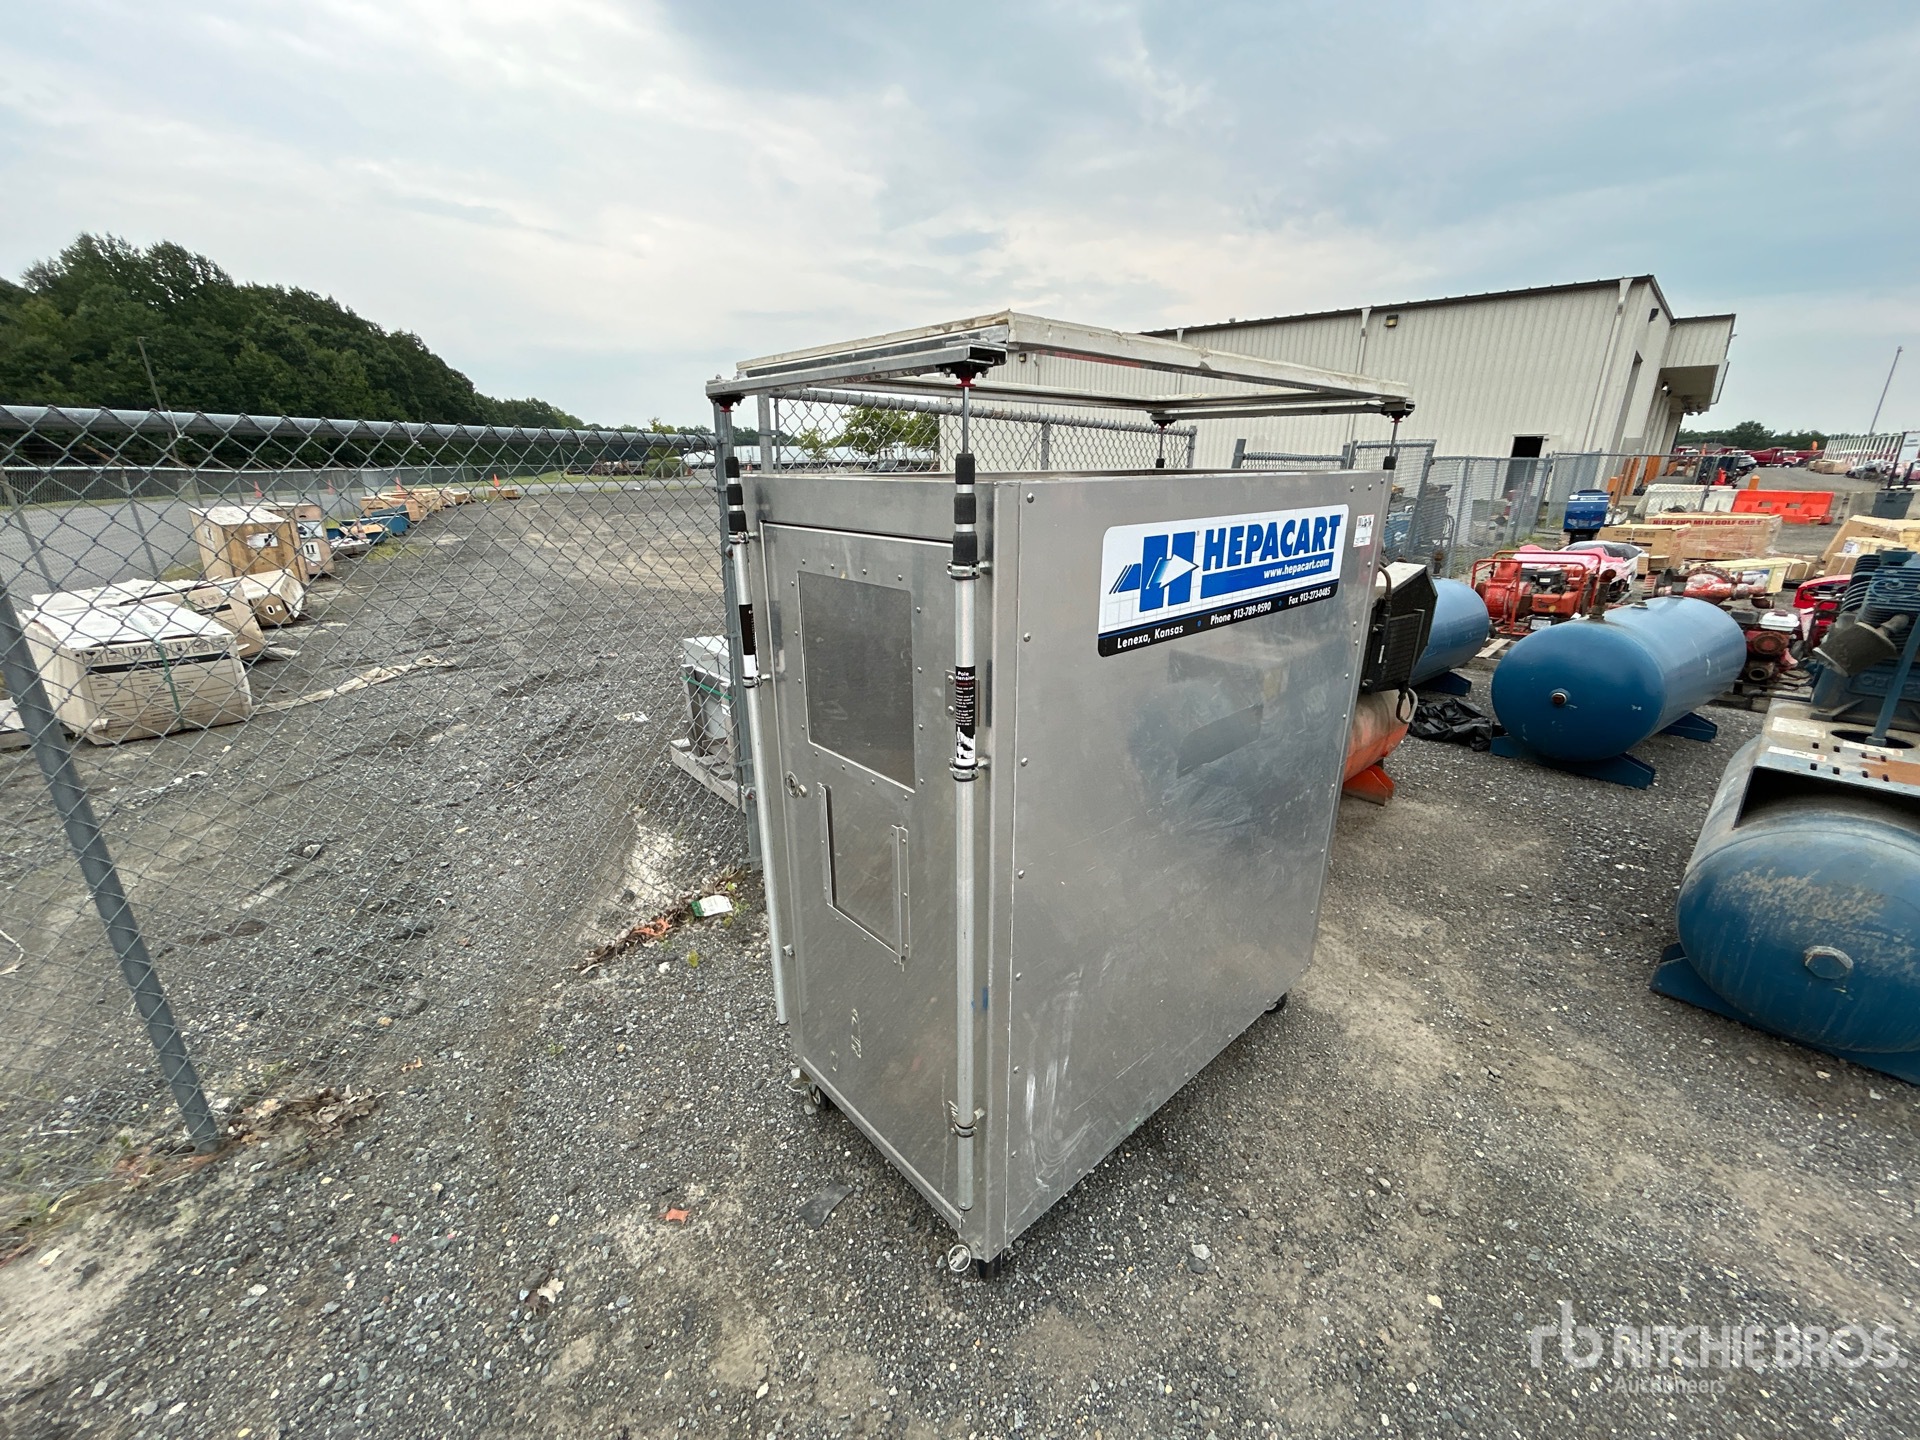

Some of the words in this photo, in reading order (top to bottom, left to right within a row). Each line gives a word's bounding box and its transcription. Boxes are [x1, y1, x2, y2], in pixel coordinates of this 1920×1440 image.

[1202, 514, 1342, 572] HEPACART
[1263, 558, 1330, 579] www.hepacart.com
[1288, 596, 1298, 605] Fax
[1210, 613, 1231, 625] Phone
[1233, 601, 1272, 619] 913-789-9590
[1117, 633, 1151, 649] Lenexa,
[1154, 625, 1184, 640] Kansas
